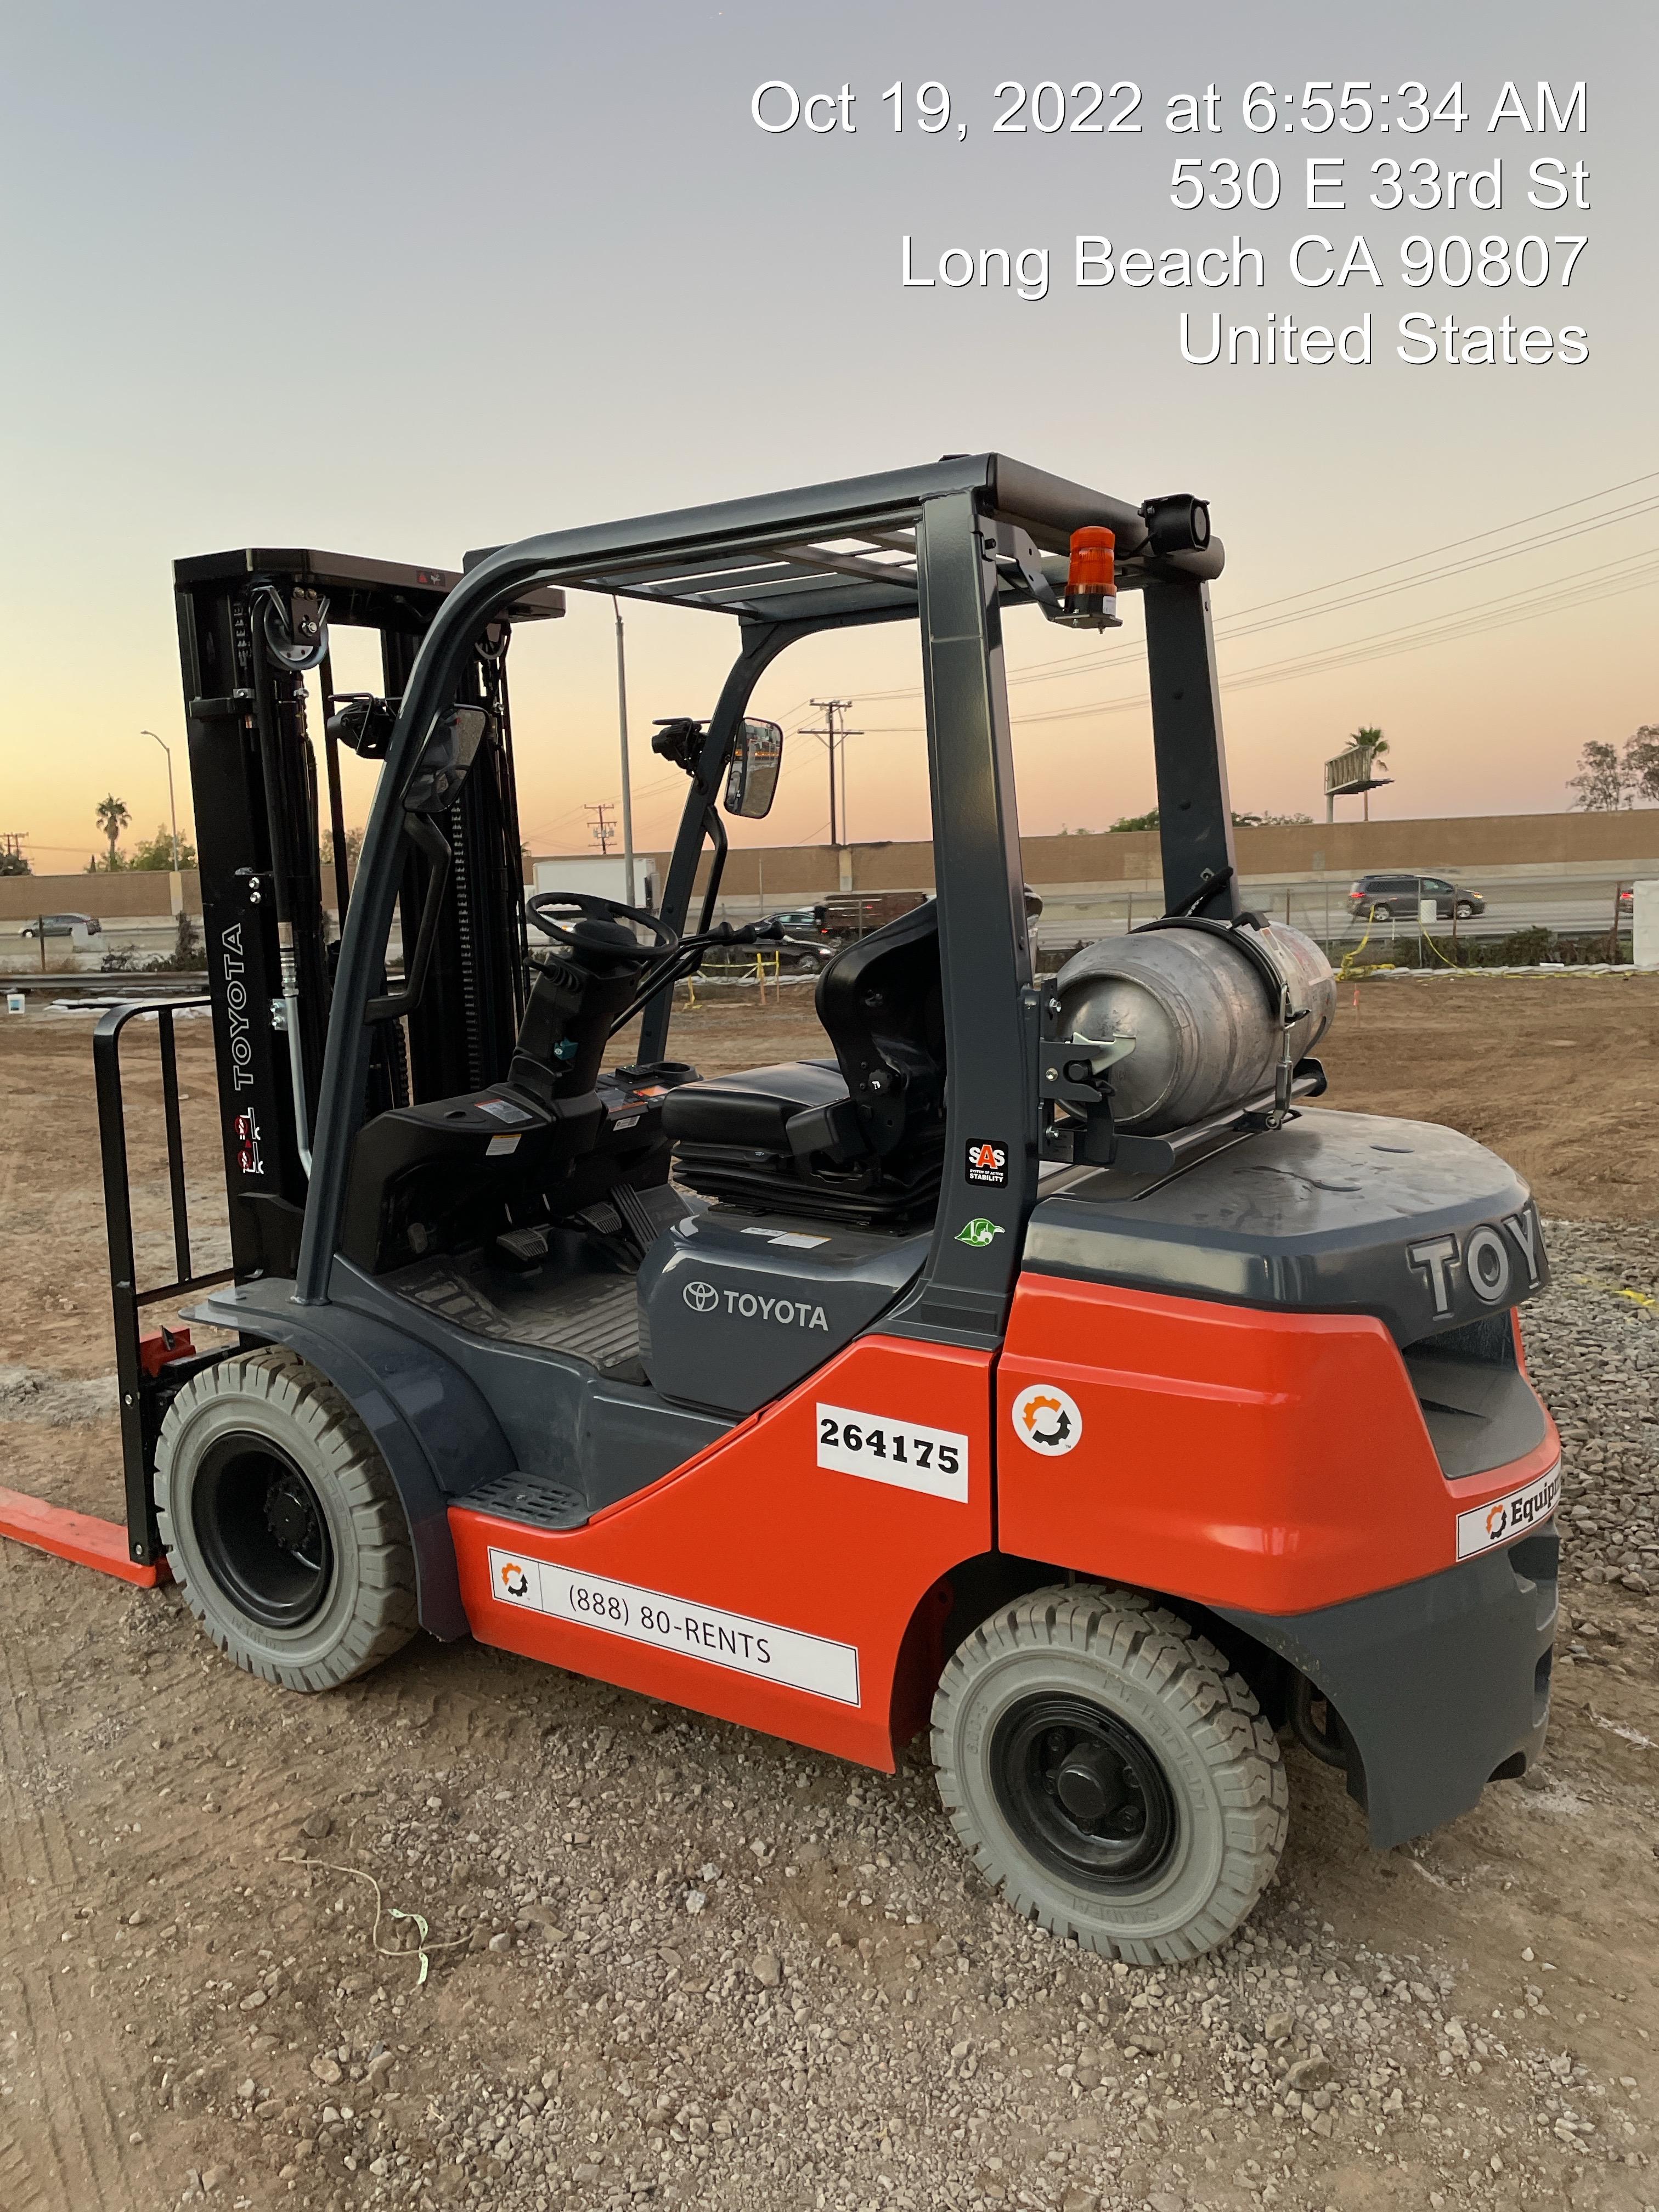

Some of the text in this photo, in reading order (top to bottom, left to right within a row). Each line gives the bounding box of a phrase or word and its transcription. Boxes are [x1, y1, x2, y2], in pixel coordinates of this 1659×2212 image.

[222, 923, 254, 1091] TOYOTA
[968, 1144, 1005, 1170] SAS
[969, 1173, 1004, 1182] STABILITY
[1408, 1200, 1549, 1321] TOY
[723, 1290, 829, 1331] TOYOTA
[820, 1419, 959, 1475] 264175
[569, 1584, 770, 1664] (888) 80-RENTS
